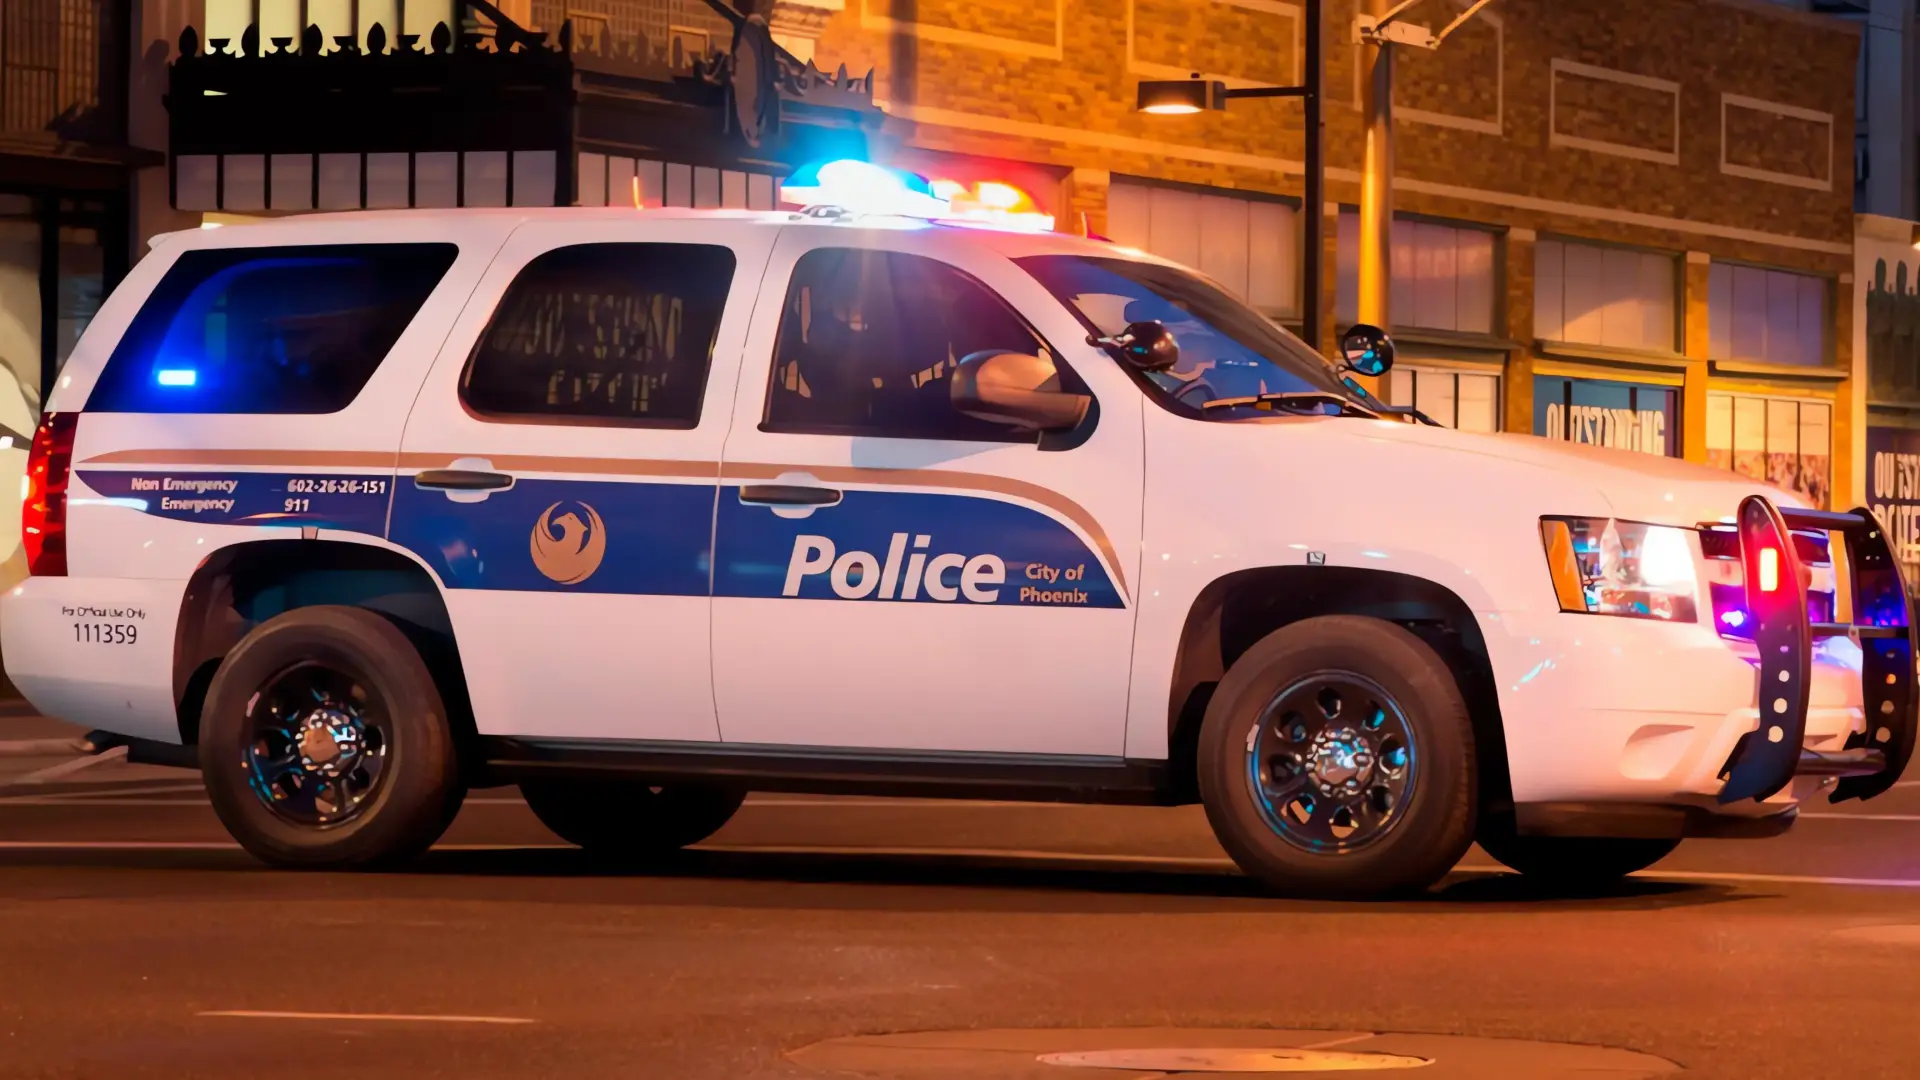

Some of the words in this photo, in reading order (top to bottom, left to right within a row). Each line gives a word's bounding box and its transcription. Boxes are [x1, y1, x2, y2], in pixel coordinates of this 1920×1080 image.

[163, 477, 238, 494] Emergency
[161, 497, 235, 513] Emergency
[284, 498, 309, 512] 911
[782, 533, 1006, 603] Police
[1025, 563, 1060, 584] City
[1064, 564, 1085, 580] of
[1020, 586, 1088, 603] Phoenix
[73, 623, 137, 644] 111359
